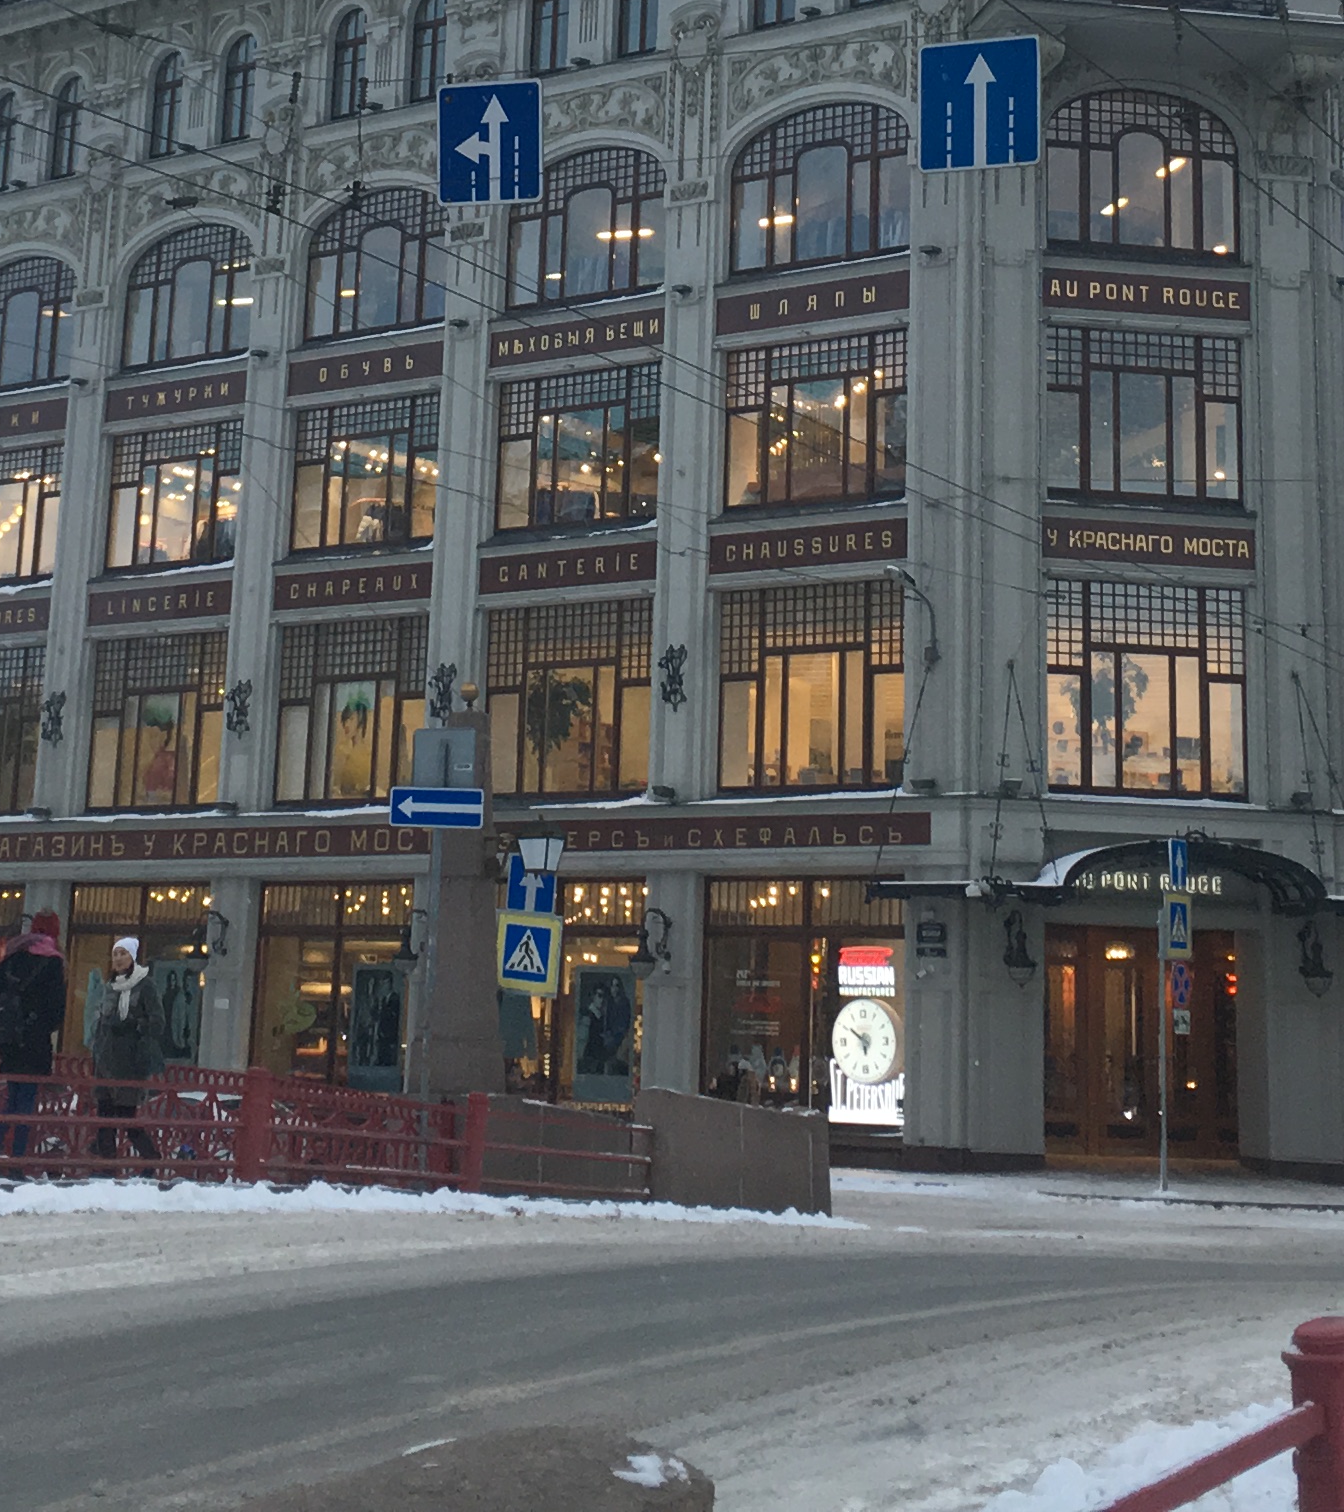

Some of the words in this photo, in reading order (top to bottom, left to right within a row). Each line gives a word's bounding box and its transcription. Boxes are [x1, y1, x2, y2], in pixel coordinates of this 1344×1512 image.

[749, 286, 876, 320] ШЛЯПЫ
[1050, 279, 1078, 297] AU
[1089, 282, 1149, 303] PONT
[1162, 287, 1241, 310] ROUGE
[606, 318, 659, 341] ВЕЩИ
[319, 354, 414, 383] ОБУВЬ
[127, 381, 229, 410] ТУЖУРКИ
[726, 530, 892, 562] CHAUSSURES
[1047, 528, 1058, 547] У
[1069, 529, 1174, 554] КРАСНАГО
[1184, 537, 1250, 559] МОСТА
[290, 573, 417, 599] CHAPEAUX
[143, 833, 156, 856] У
[172, 830, 331, 856] КРАСНАГО
[350, 827, 433, 853] МОСТ
[498, 830, 650, 850] ЭЕРСЪ
[1101, 870, 1150, 891] PONT
[1160, 873, 1222, 895] RUGE
[838, 966, 895, 985] RUSSIAN
